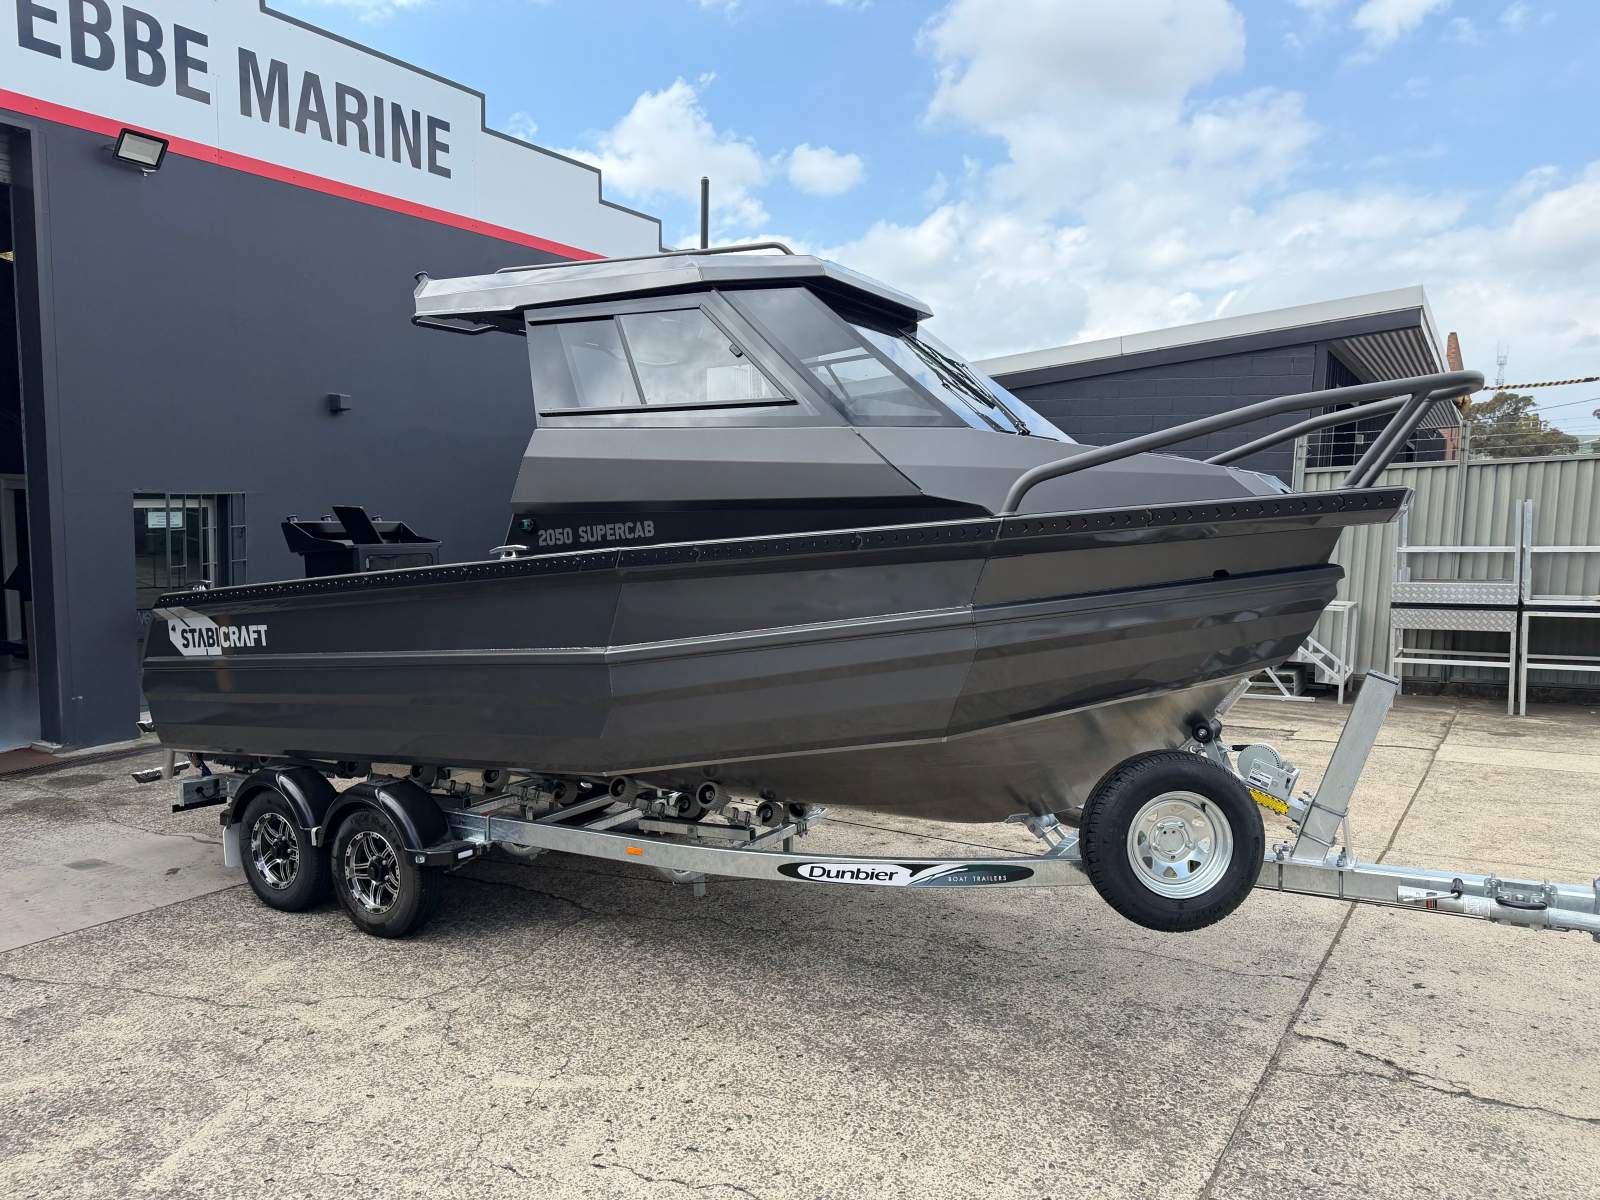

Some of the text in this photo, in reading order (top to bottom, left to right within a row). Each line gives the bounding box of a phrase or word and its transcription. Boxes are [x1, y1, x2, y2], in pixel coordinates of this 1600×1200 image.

[16, 0, 452, 180] EBBE MARINE
[538, 520, 655, 547] 2050 SUPERCAB
[180, 624, 268, 649] STABICRAFT
[808, 865, 899, 881] Dunbier
